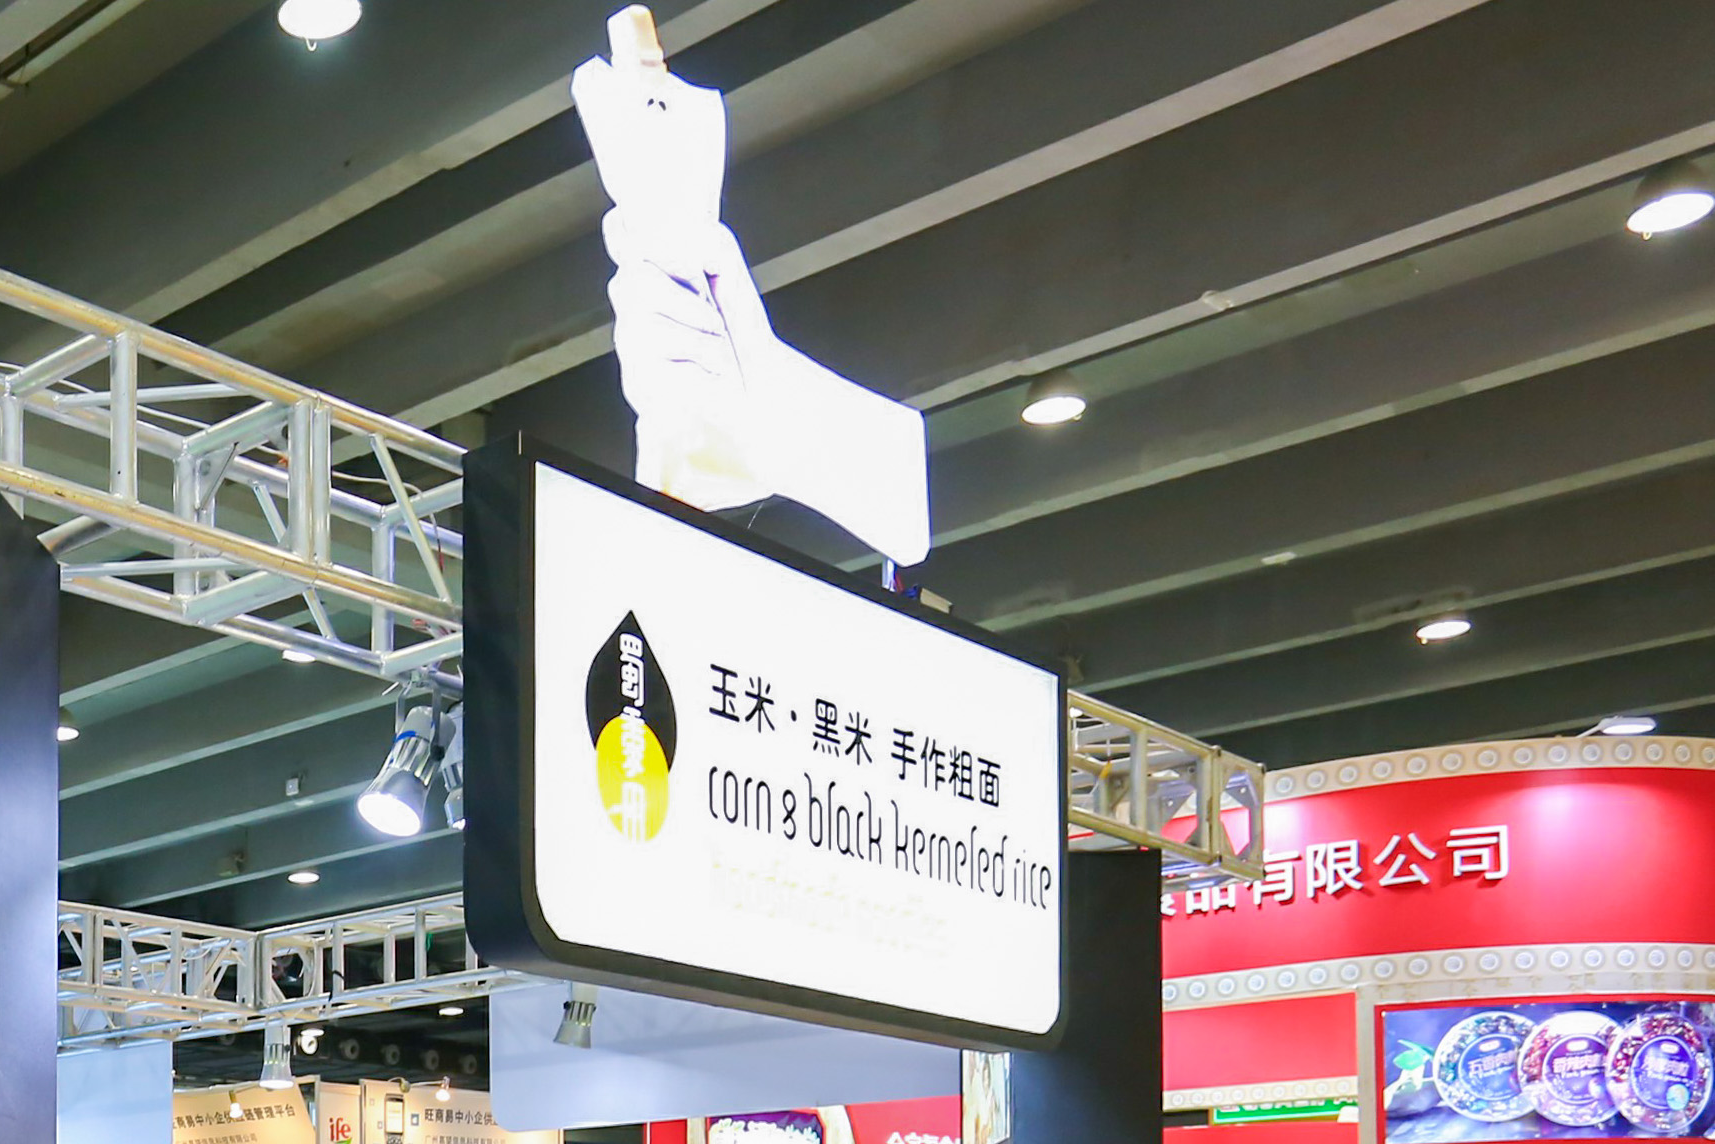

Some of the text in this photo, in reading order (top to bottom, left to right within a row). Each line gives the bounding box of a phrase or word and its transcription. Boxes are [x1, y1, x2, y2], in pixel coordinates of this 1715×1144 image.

[890, 728, 1002, 808] 手作粗面
[708, 765, 772, 835] corn
[804, 772, 883, 865] black
[891, 799, 1008, 899] kerneled
[1013, 849, 1054, 910] rice
[1161, 825, 1511, 915] 品有限公司
[329, 1117, 352, 1142] ife
[424, 1108, 498, 1126] 旺商易中小企供
